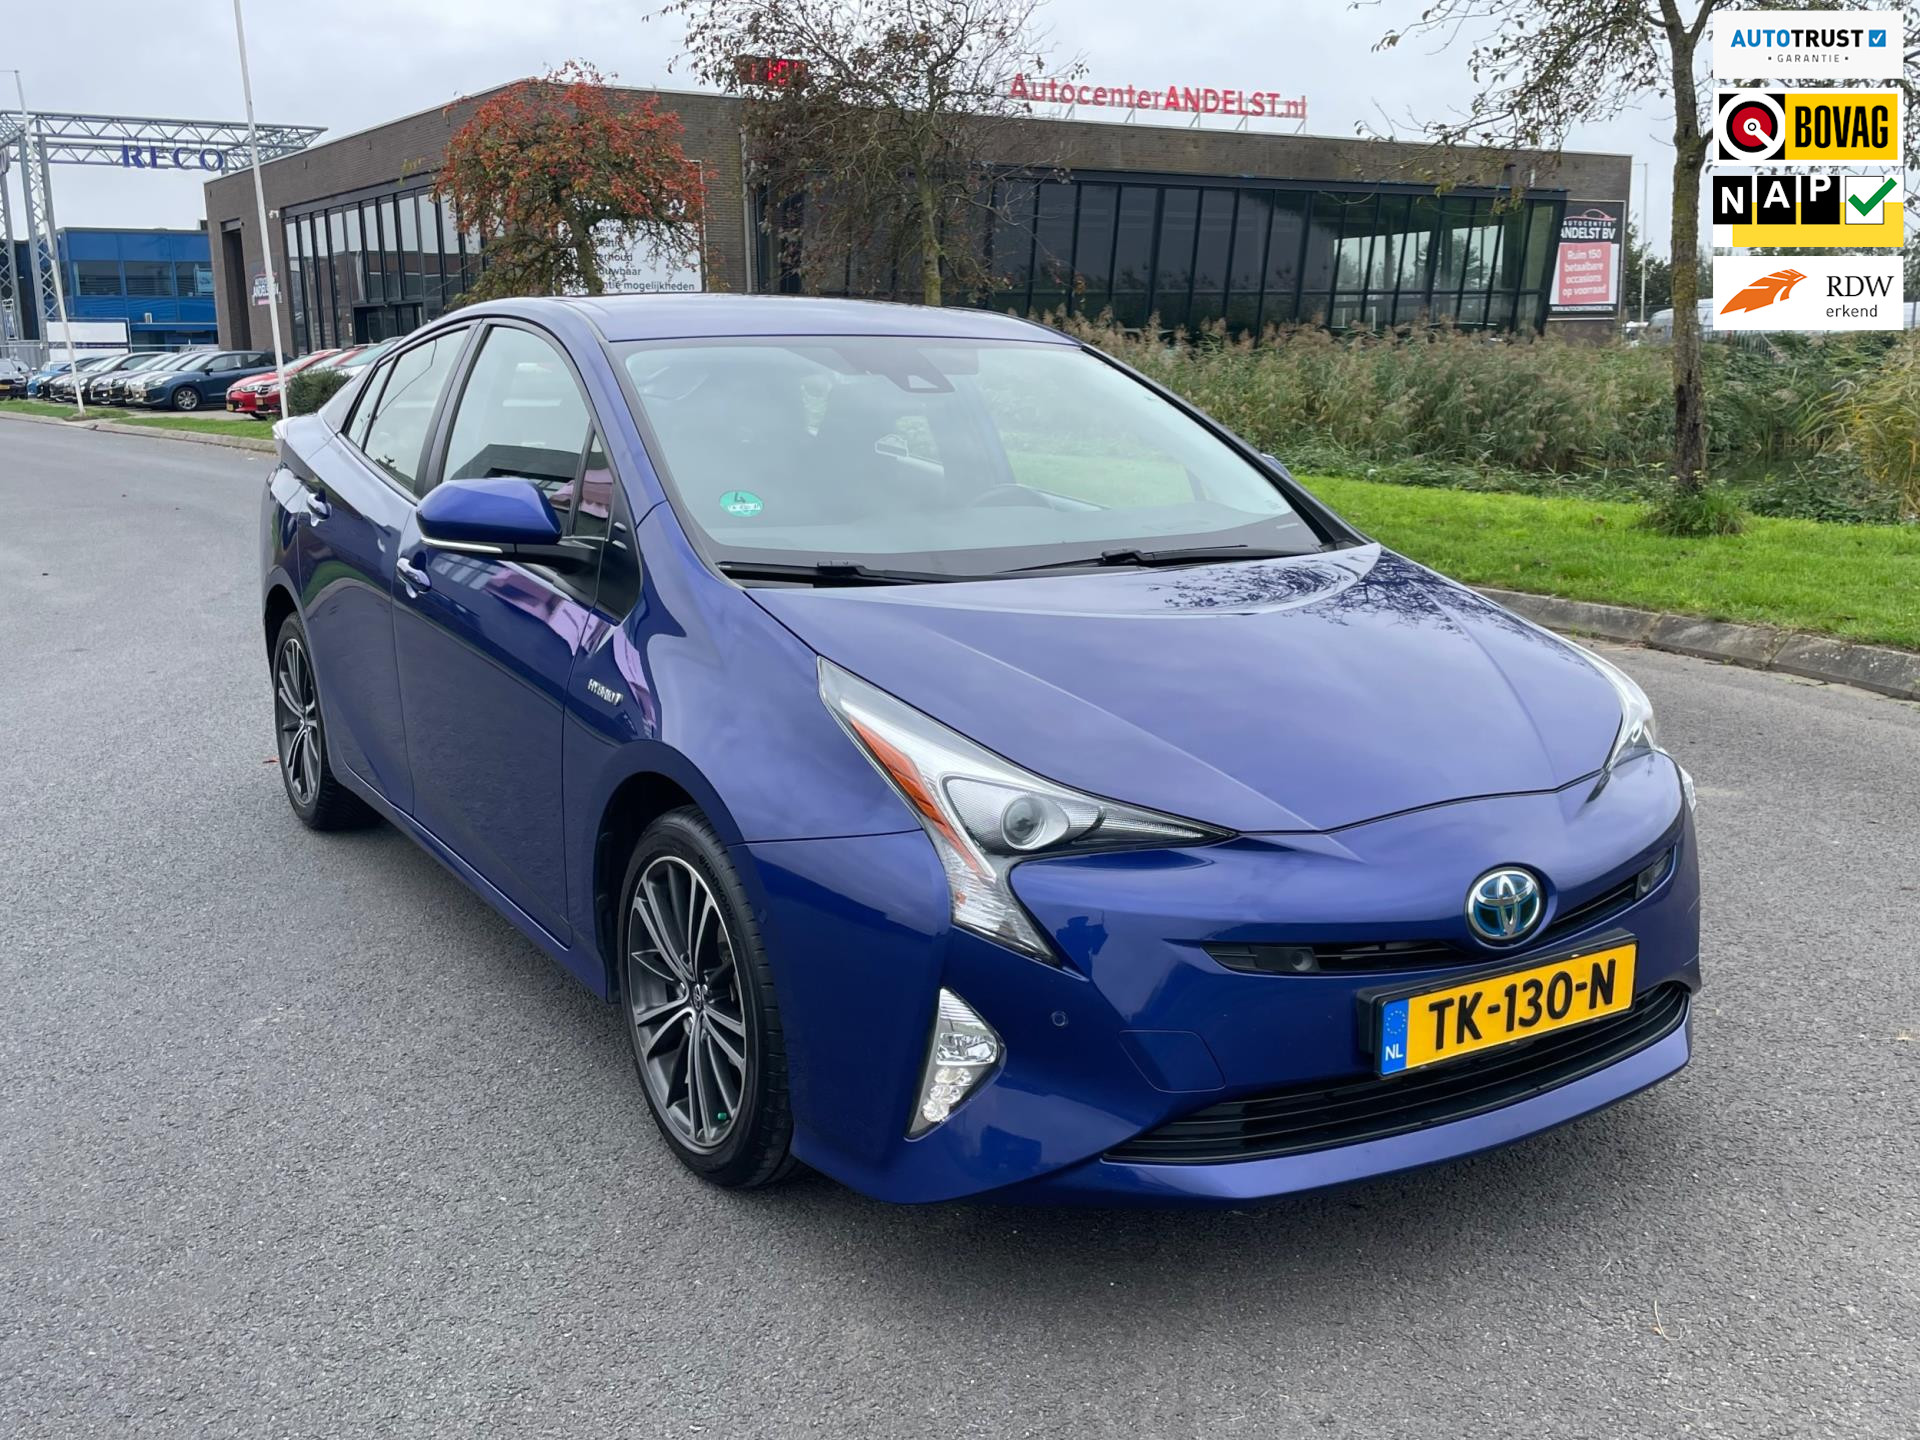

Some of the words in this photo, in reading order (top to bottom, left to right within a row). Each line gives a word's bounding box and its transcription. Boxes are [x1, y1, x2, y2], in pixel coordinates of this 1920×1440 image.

[1009, 73, 1307, 118] AutocenterANDELST.nl
[121, 144, 224, 172] RECO
[1561, 227, 1601, 239] ANDELST
[1602, 228, 1616, 239] BV
[1567, 250, 1587, 260] Ruim
[624, 281, 695, 293] mogelijkheden
[1428, 958, 1616, 1051] TK-130-N
[1384, 1043, 1403, 1061] NL
